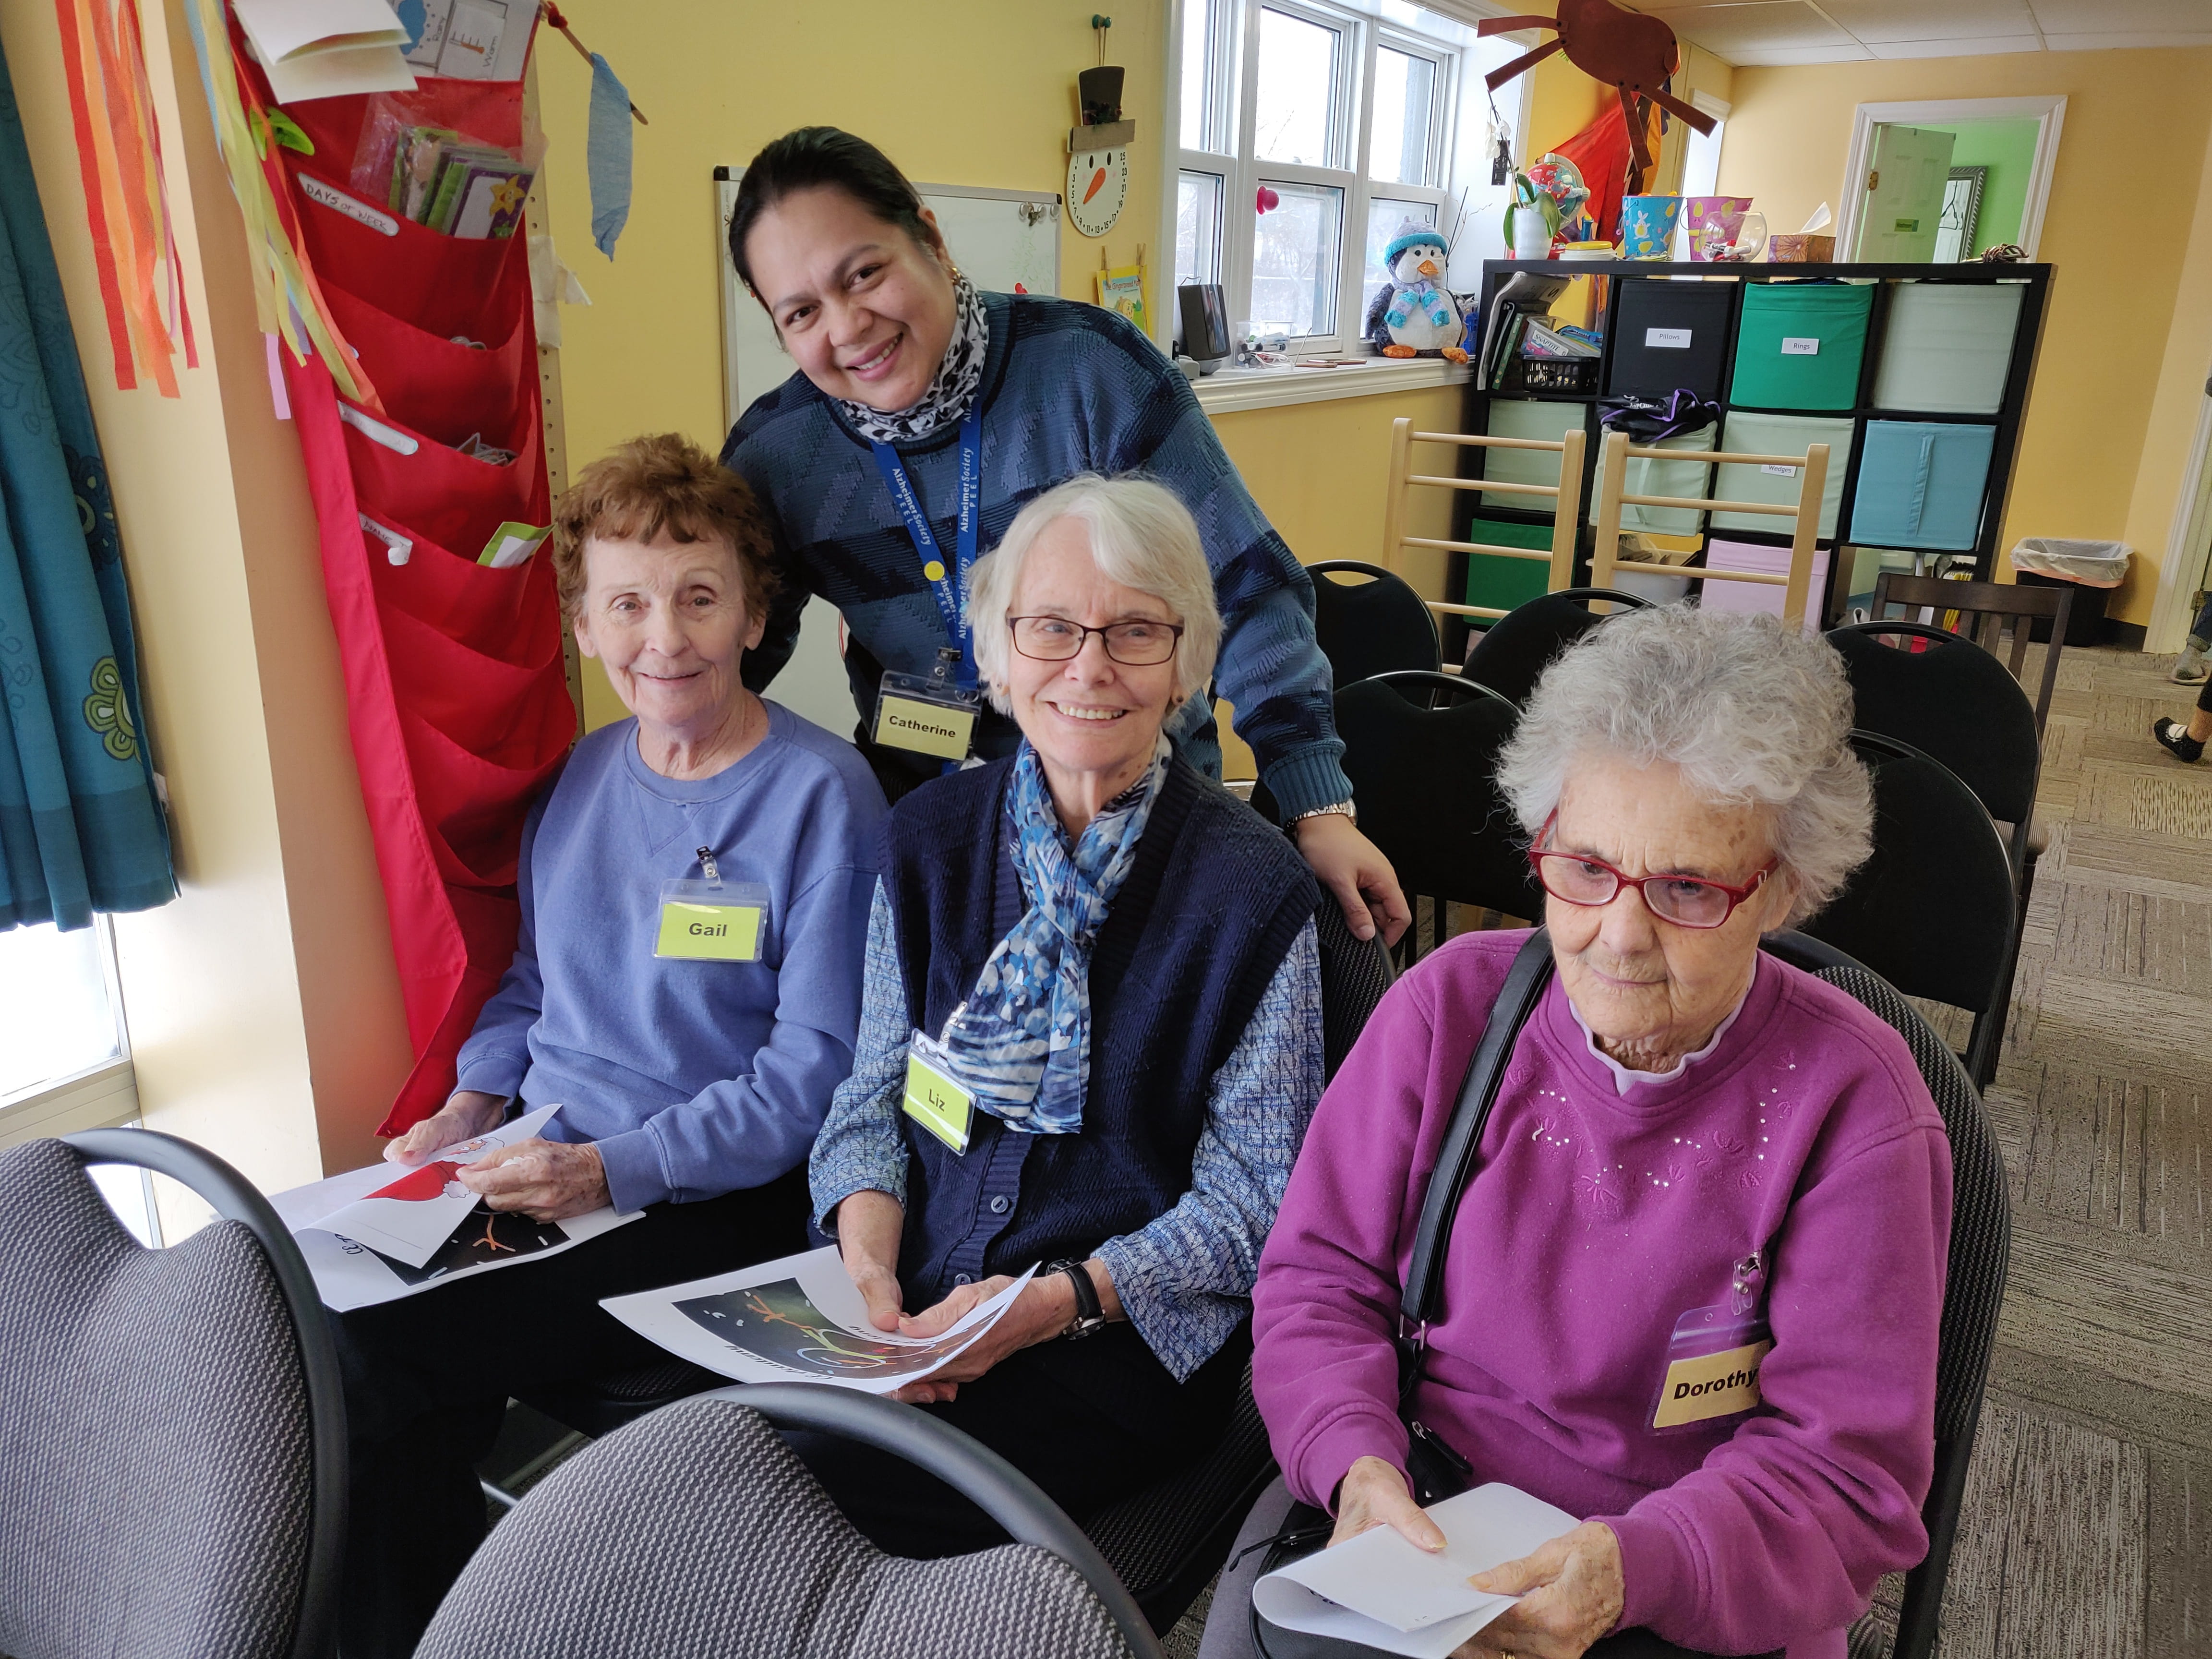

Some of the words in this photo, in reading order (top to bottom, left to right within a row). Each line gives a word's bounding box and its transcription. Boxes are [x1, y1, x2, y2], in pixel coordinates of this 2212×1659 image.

[1120, 152, 1126, 161] 25
[1122, 168, 1127, 176] 23
[1072, 174, 1076, 182] 3
[1122, 184, 1126, 192] 21
[1071, 190, 1075, 198] 5
[306, 184, 339, 205] DAYS
[358, 211, 387, 231] WEEK
[1118, 200, 1123, 208] 19
[1074, 207, 1077, 216] 7
[1112, 213, 1117, 221] 17
[1086, 225, 1090, 233] 11
[1104, 221, 1109, 229] 15
[1095, 226, 1100, 234] 13
[1769, 464, 1792, 473] Wedges
[889, 715, 956, 738] Catherine
[689, 923, 728, 937] Gail
[928, 1088, 946, 1112] Liz
[1673, 1368, 1758, 1400] Dorothy
